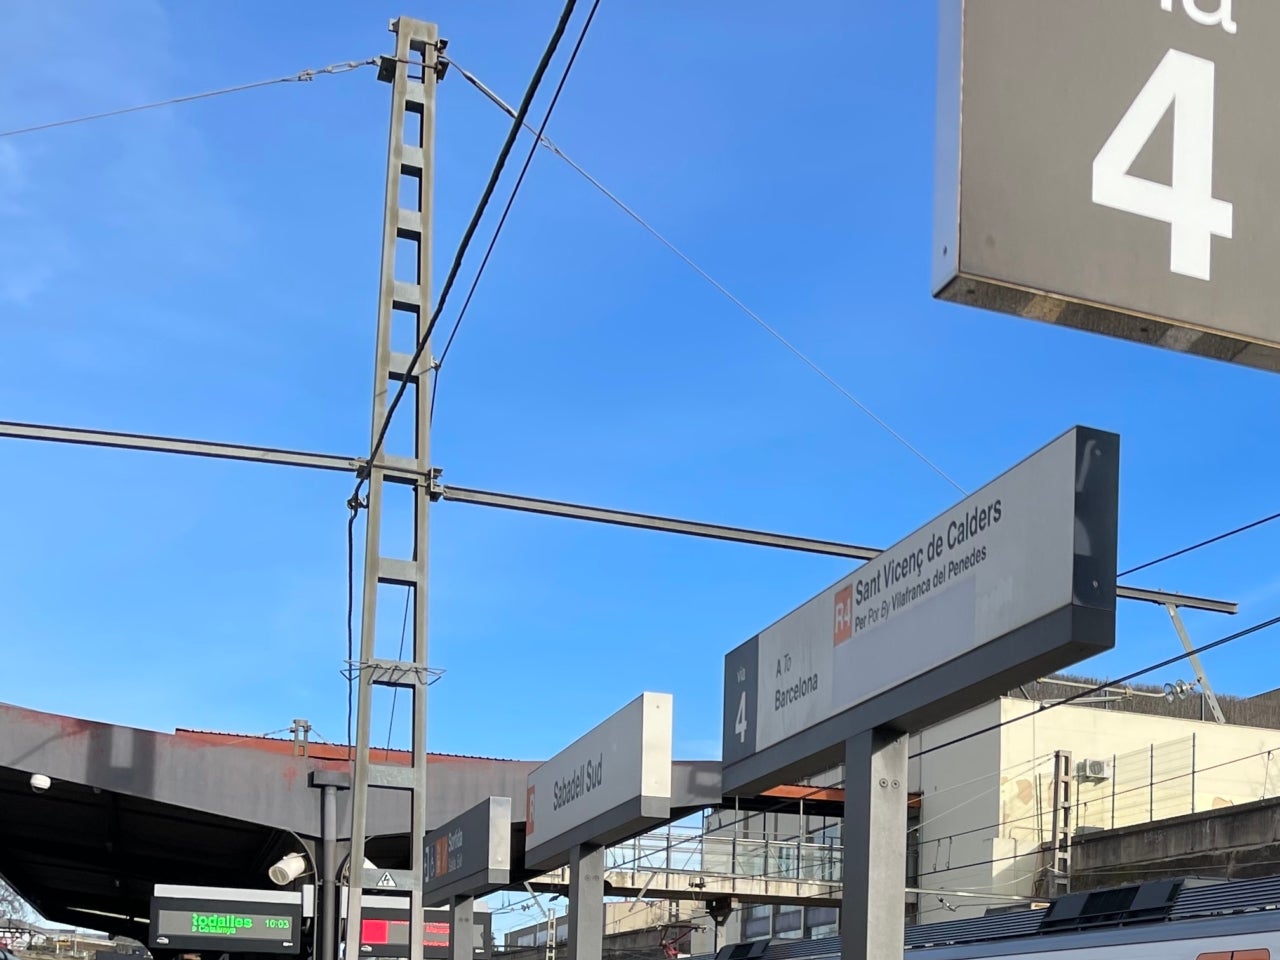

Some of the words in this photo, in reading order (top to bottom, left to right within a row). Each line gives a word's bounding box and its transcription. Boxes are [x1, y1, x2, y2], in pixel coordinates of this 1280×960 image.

[1092, 49, 1233, 281] 4
[855, 568, 881, 606] Sant
[883, 547, 924, 590] Vicenç
[927, 533, 944, 564] de
[947, 500, 1001, 550] Calders
[855, 615, 867, 633] Per
[868, 605, 880, 625] Por
[880, 599, 891, 621] By
[891, 580, 931, 612] Vilafranca
[932, 565, 946, 588] del
[774, 673, 819, 711] Barcelona
[776, 658, 782, 678] A
[784, 653, 792, 673] To
[735, 691, 747, 743] 4
[553, 764, 585, 811] Sabadell
[586, 752, 603, 792] Sud
[265, 919, 290, 929] 10:03
